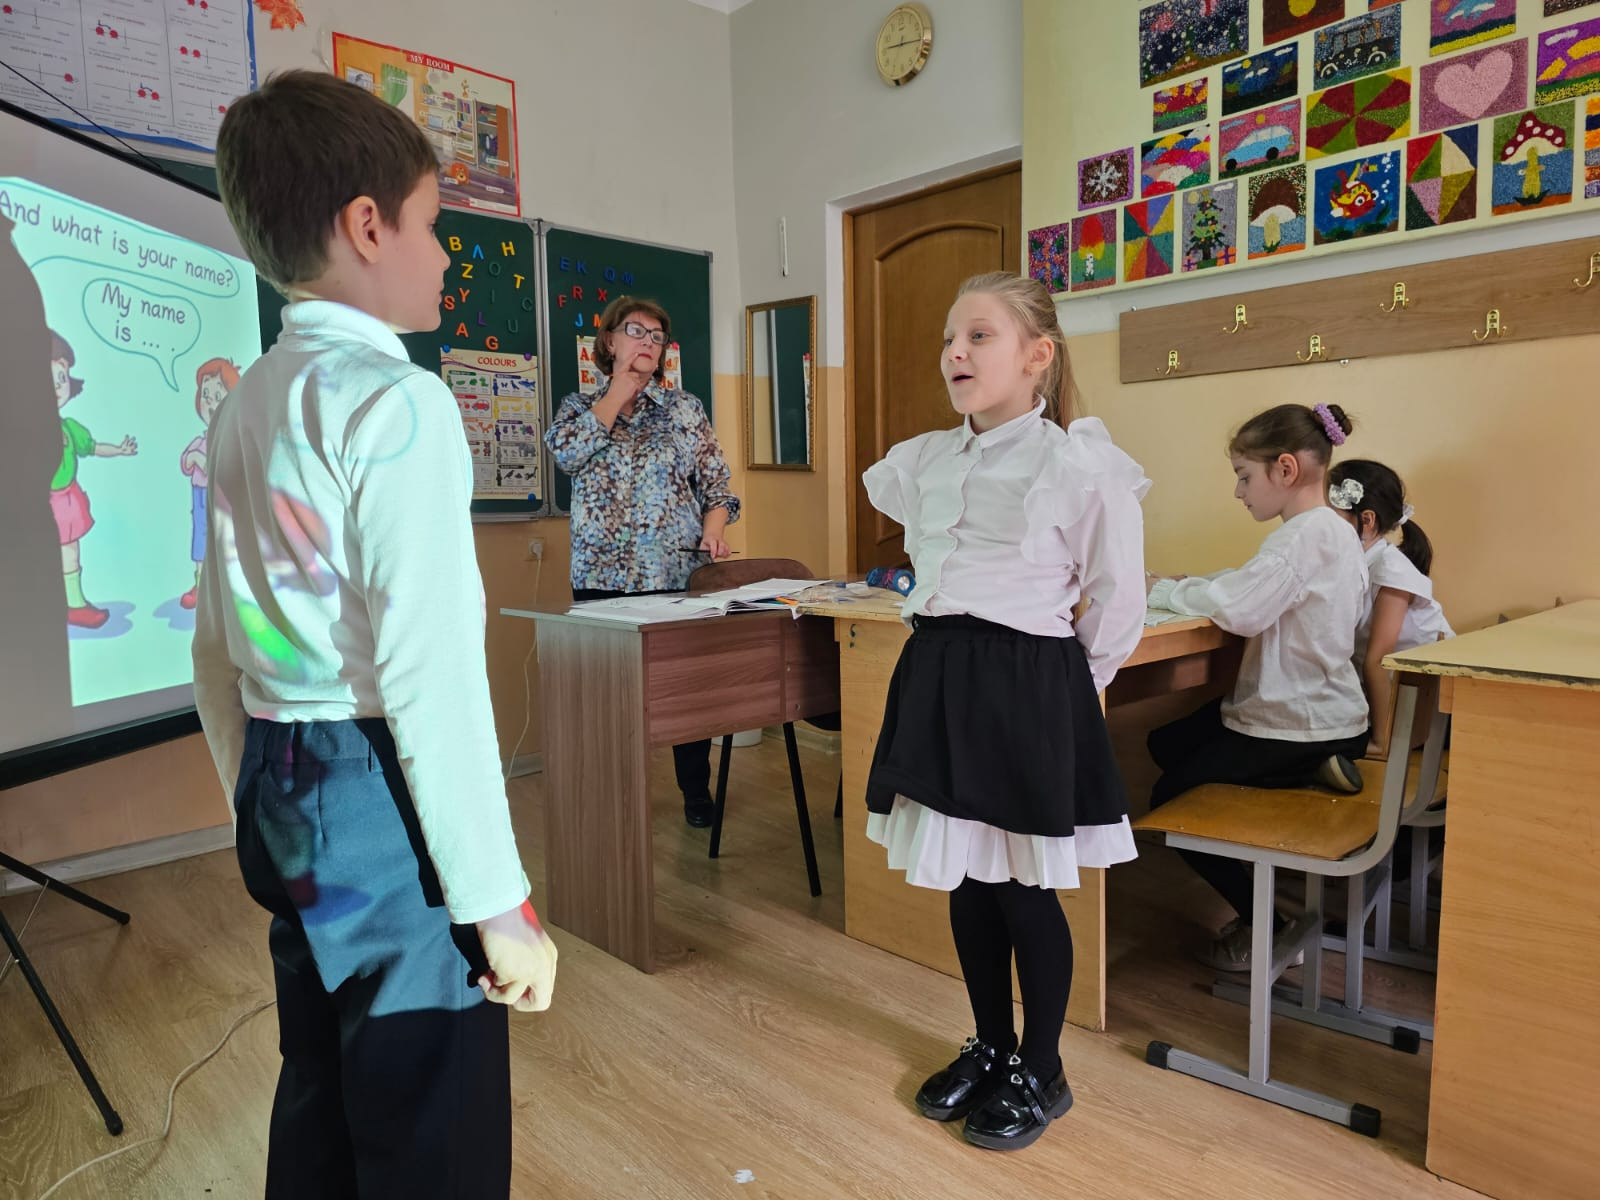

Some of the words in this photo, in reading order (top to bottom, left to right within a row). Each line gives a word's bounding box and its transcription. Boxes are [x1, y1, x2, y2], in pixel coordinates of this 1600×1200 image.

[410, 54, 424, 64] MY
[426, 58, 450, 70] ROOM
[0, 190, 41, 225] And
[52, 215, 102, 246] what
[112, 231, 129, 255] is
[137, 244, 178, 270] your
[185, 258, 234, 287] name?
[448, 236, 463, 252] B
[501, 241, 516, 257] H
[461, 263, 474, 279] Z
[513, 273, 525, 289] T
[459, 288, 471, 303] Y
[572, 285, 583, 300] R
[597, 287, 608, 302] X
[101, 283, 132, 319] My
[141, 298, 186, 325] name
[444, 295, 455, 310] S
[557, 294, 567, 308] F
[478, 312, 488, 326] L
[575, 312, 584, 328] J
[115, 320, 132, 343] is
[456, 322, 469, 338] A
[485, 336, 499, 351] G
[477, 356, 517, 368] COLOURS
